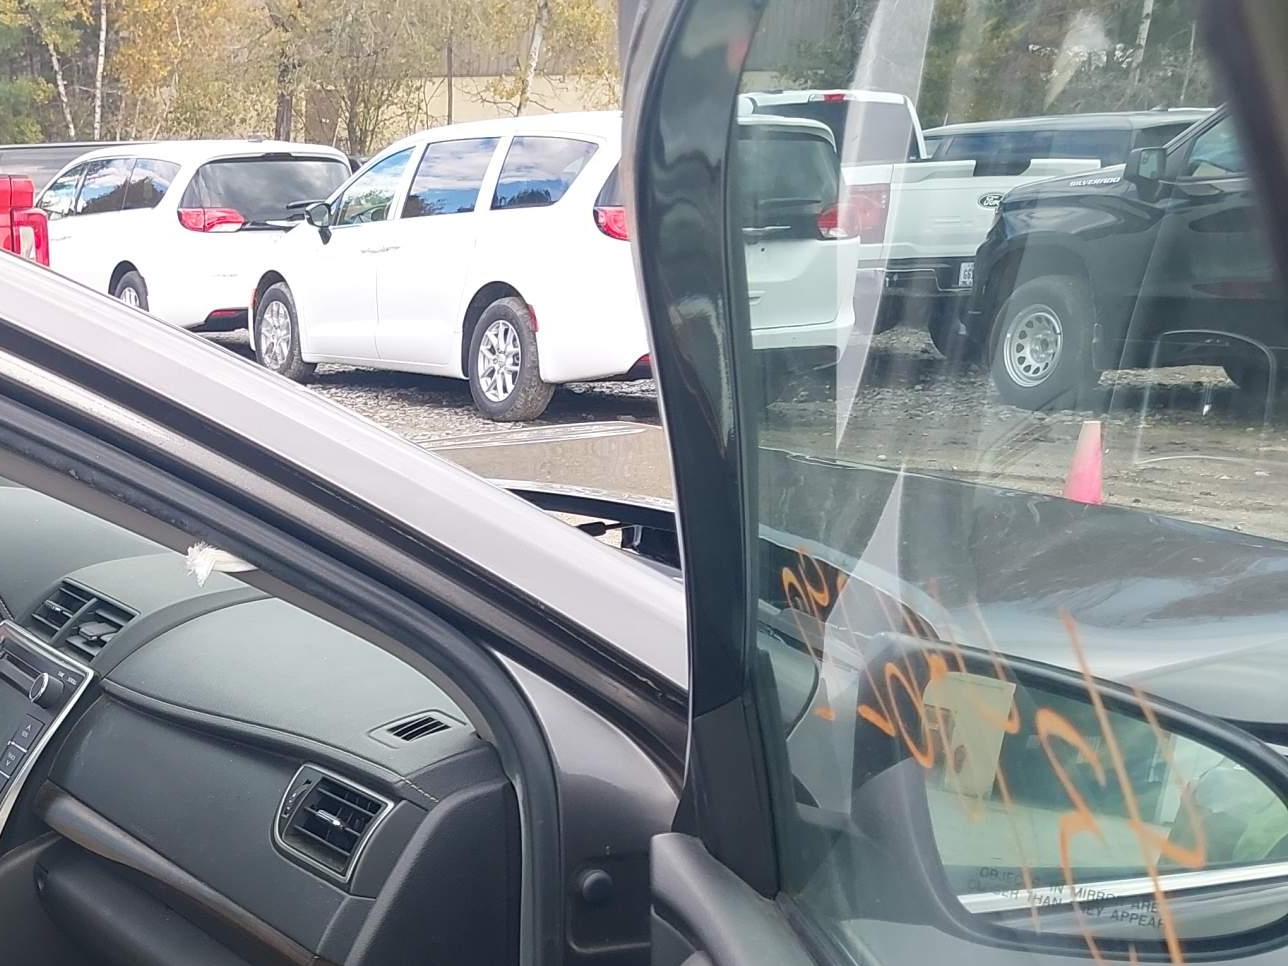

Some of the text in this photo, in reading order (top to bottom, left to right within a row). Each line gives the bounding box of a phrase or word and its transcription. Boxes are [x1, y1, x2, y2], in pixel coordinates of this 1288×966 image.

[1069, 176, 1122, 187] SILVERADO
[979, 866, 1040, 887] OBJEC
[1049, 884, 1065, 895] IN
[1071, 886, 1123, 903] MIRRO
